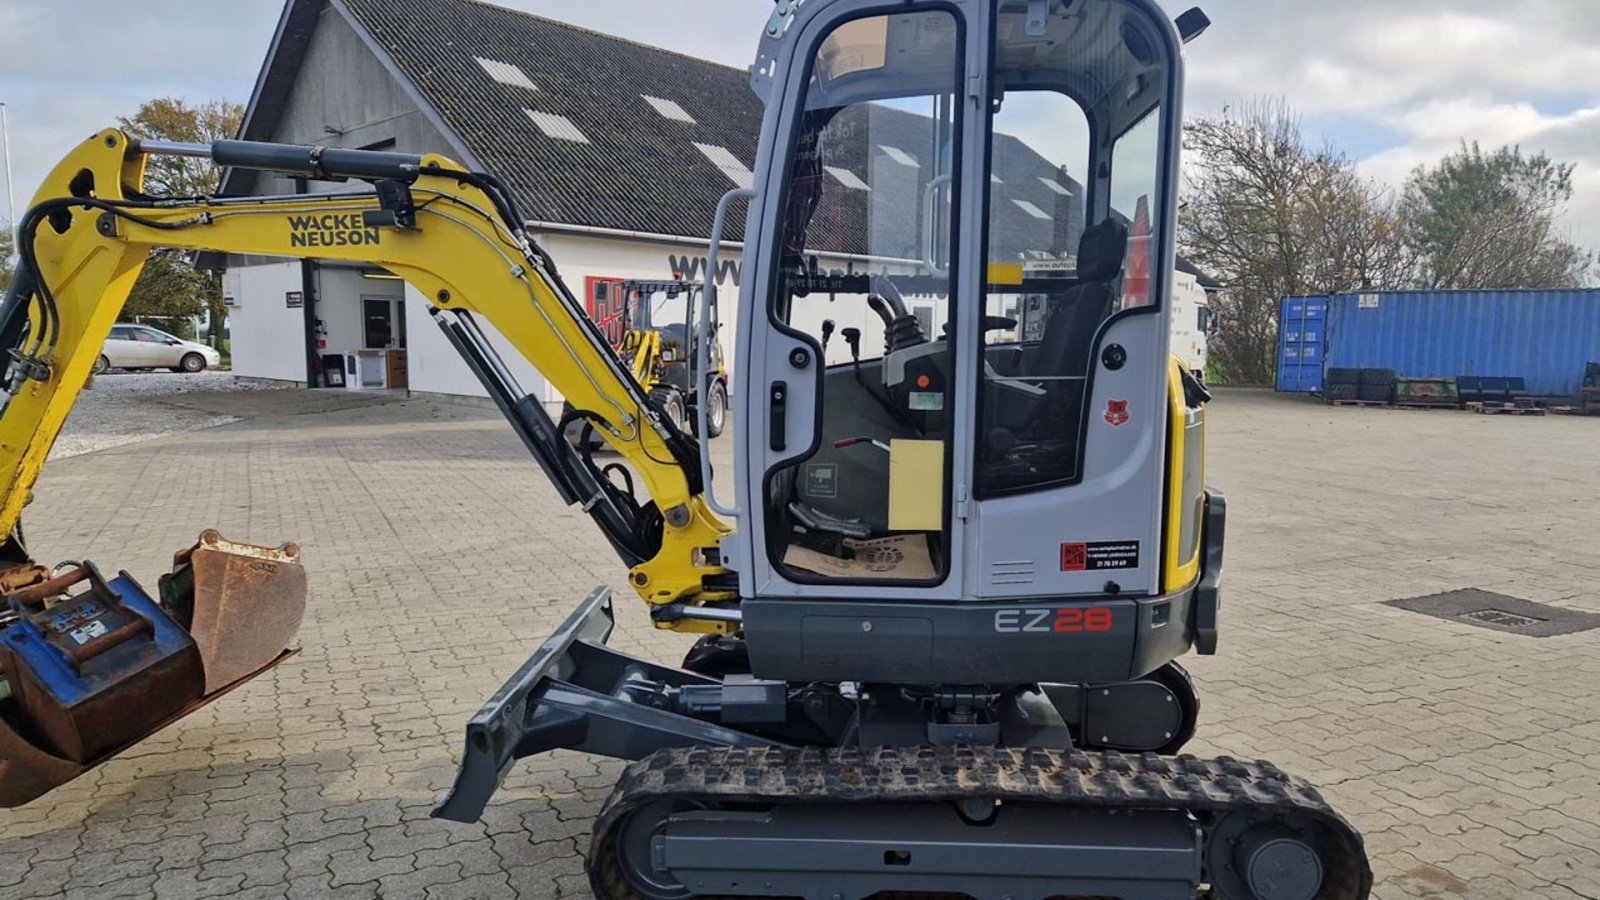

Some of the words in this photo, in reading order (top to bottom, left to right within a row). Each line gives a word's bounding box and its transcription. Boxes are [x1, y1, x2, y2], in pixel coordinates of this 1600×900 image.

[287, 214, 363, 231] WACKE
[291, 229, 380, 247] NEUSON
[994, 607, 1113, 633] EZ28
